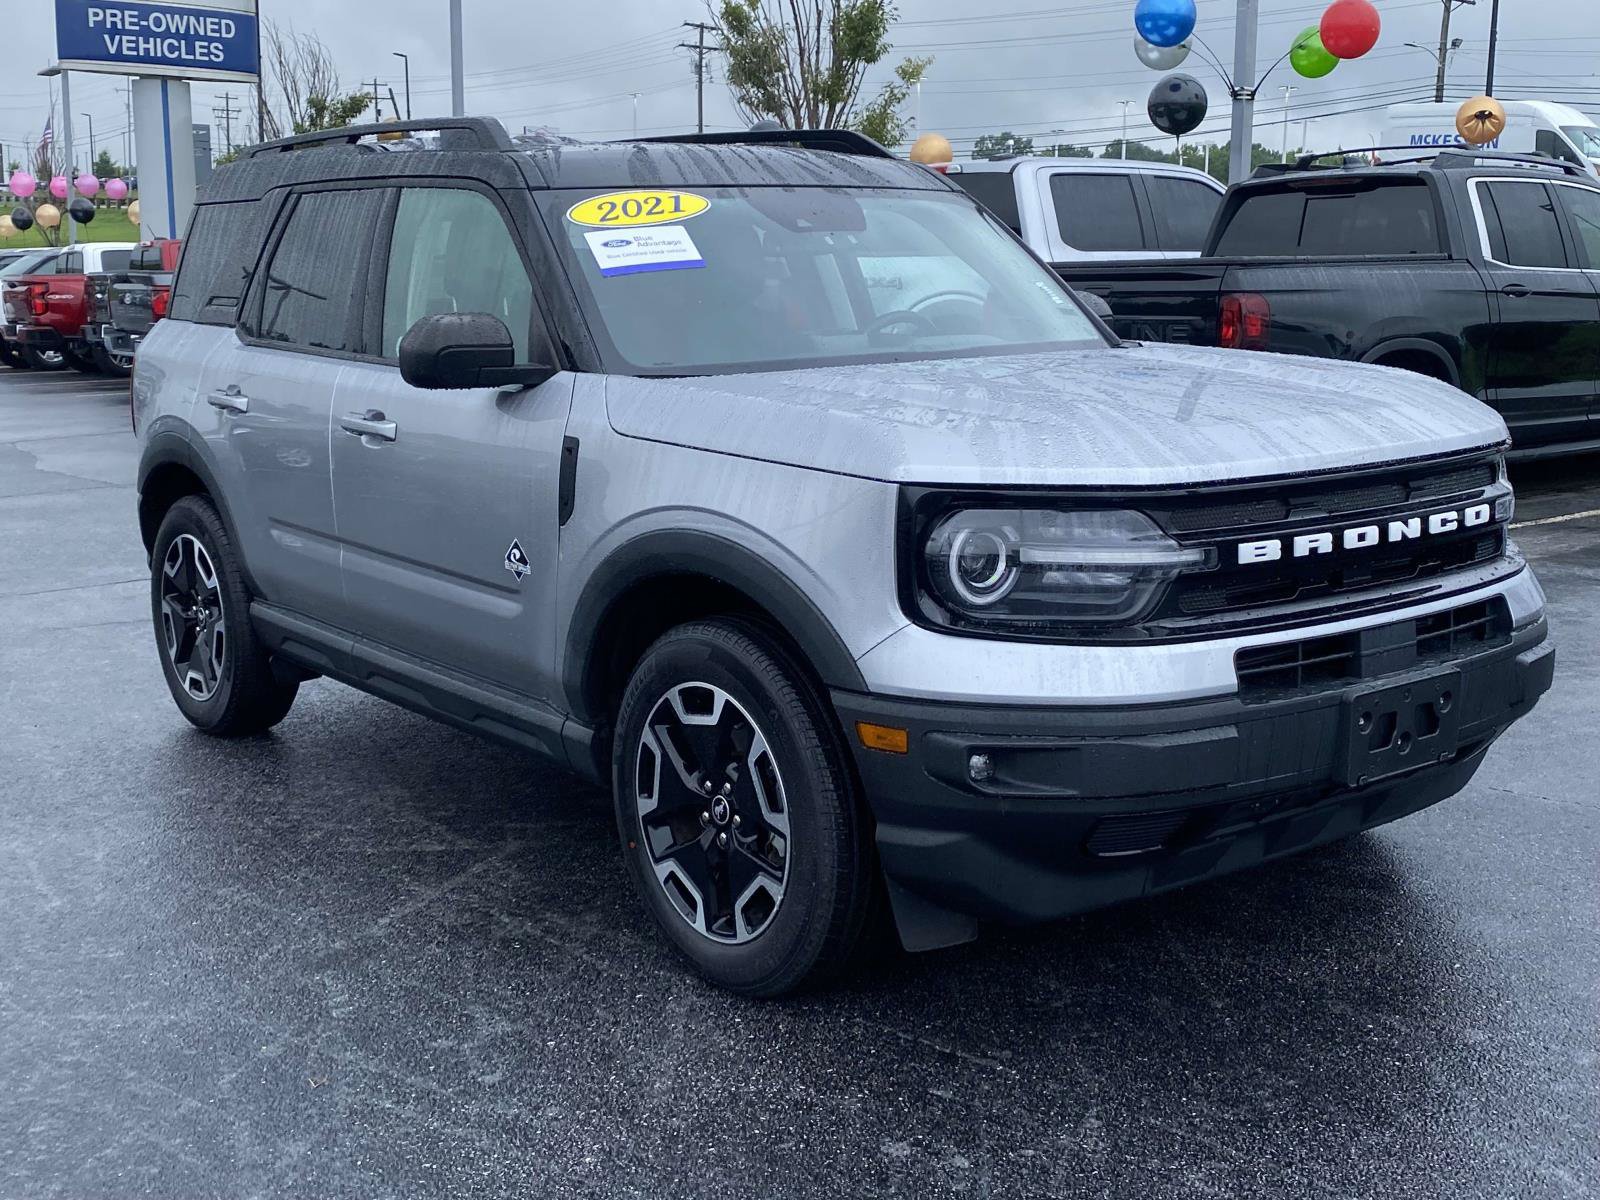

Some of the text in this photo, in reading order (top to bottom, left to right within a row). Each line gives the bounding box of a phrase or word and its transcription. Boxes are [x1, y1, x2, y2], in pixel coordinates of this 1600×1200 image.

[88, 7, 236, 38] PRE-OWNED
[103, 34, 225, 62] VEHICLES
[597, 195, 686, 222] 2021
[1237, 503, 1490, 565] BRONCO
